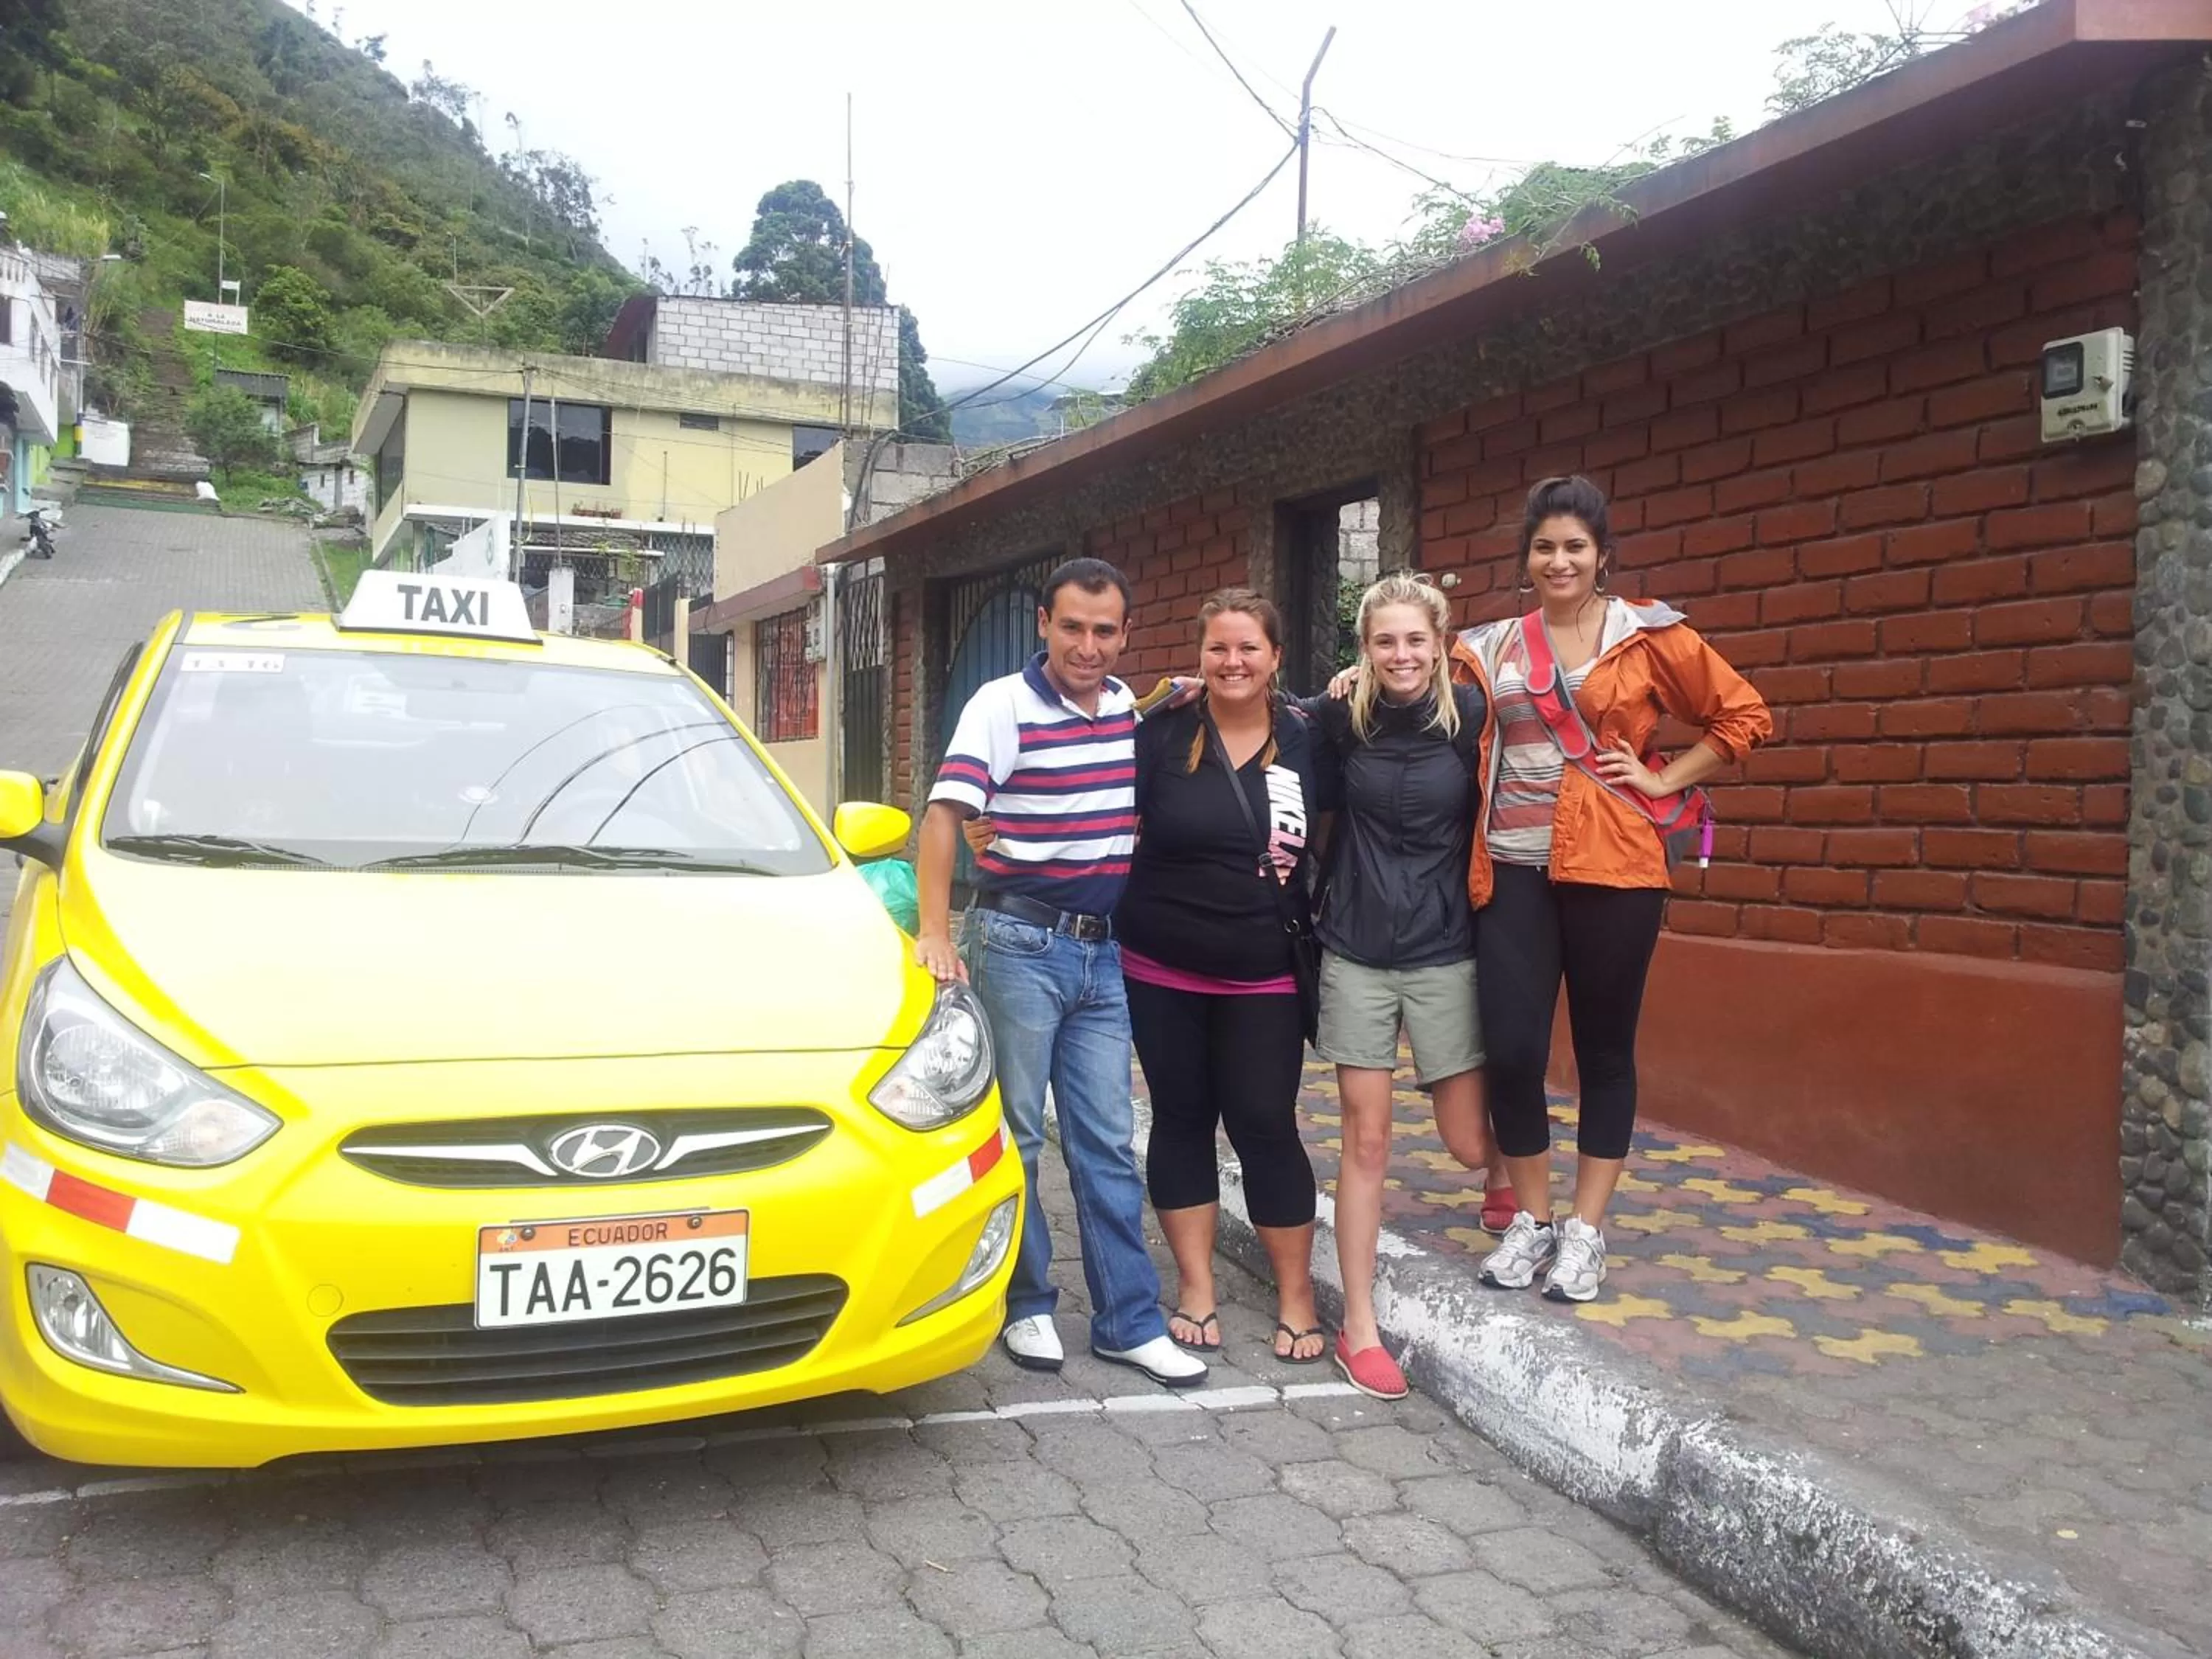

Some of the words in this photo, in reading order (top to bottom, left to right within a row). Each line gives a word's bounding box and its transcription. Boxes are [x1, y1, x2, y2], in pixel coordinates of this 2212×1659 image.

[397, 583, 489, 626] TAXI
[1265, 764, 1307, 839] NIKE
[568, 1222, 668, 1248] ECUADOR
[489, 1247, 737, 1317] TAA-2626
